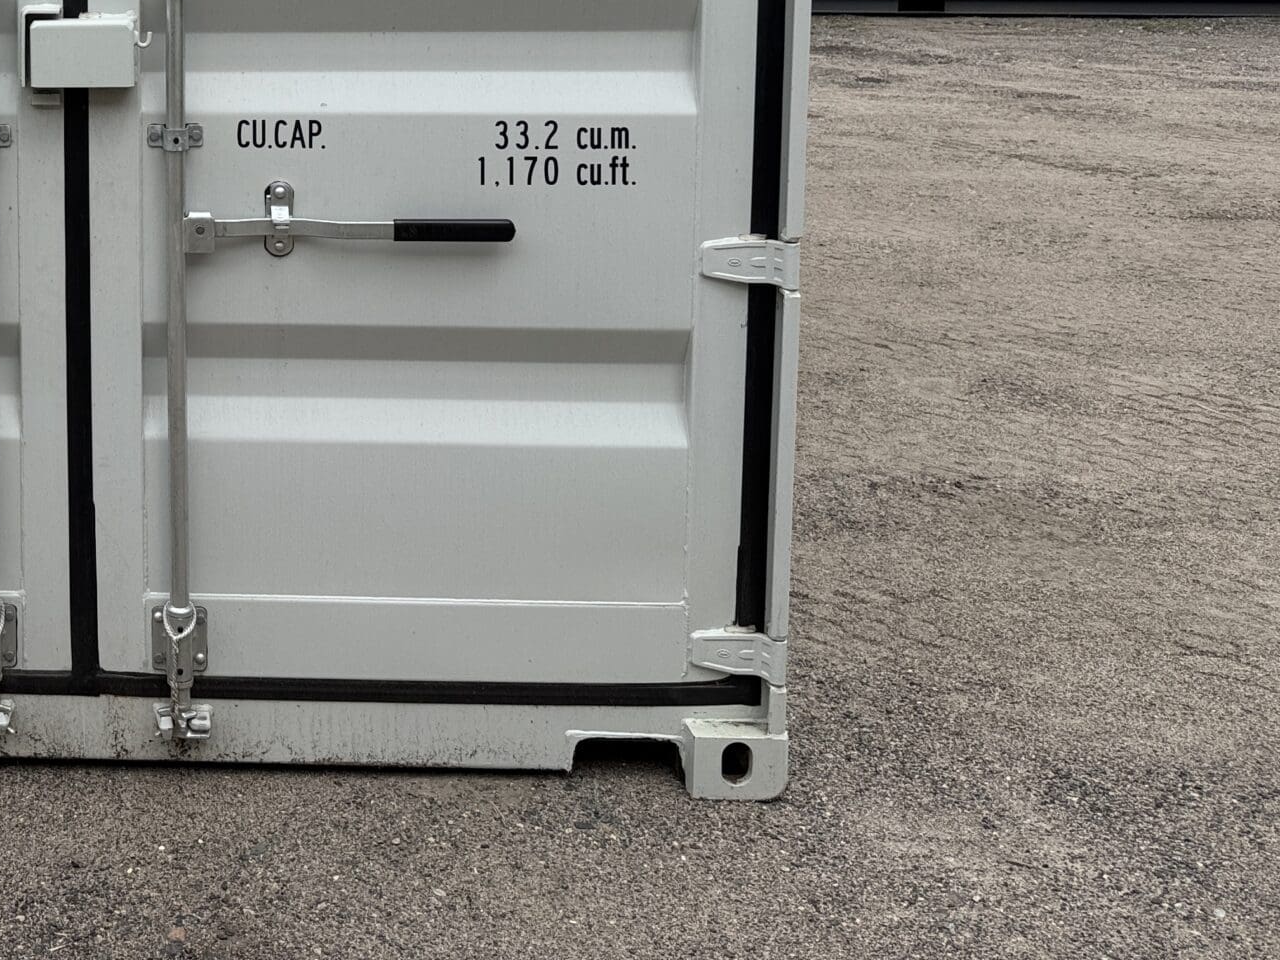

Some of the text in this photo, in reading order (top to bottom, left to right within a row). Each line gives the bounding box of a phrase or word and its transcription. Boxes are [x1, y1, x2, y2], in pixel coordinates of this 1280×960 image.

[237, 120, 636, 149] CU.CAP. 33.2 cu.m.
[479, 156, 636, 186] 1,170 cu.ft.
